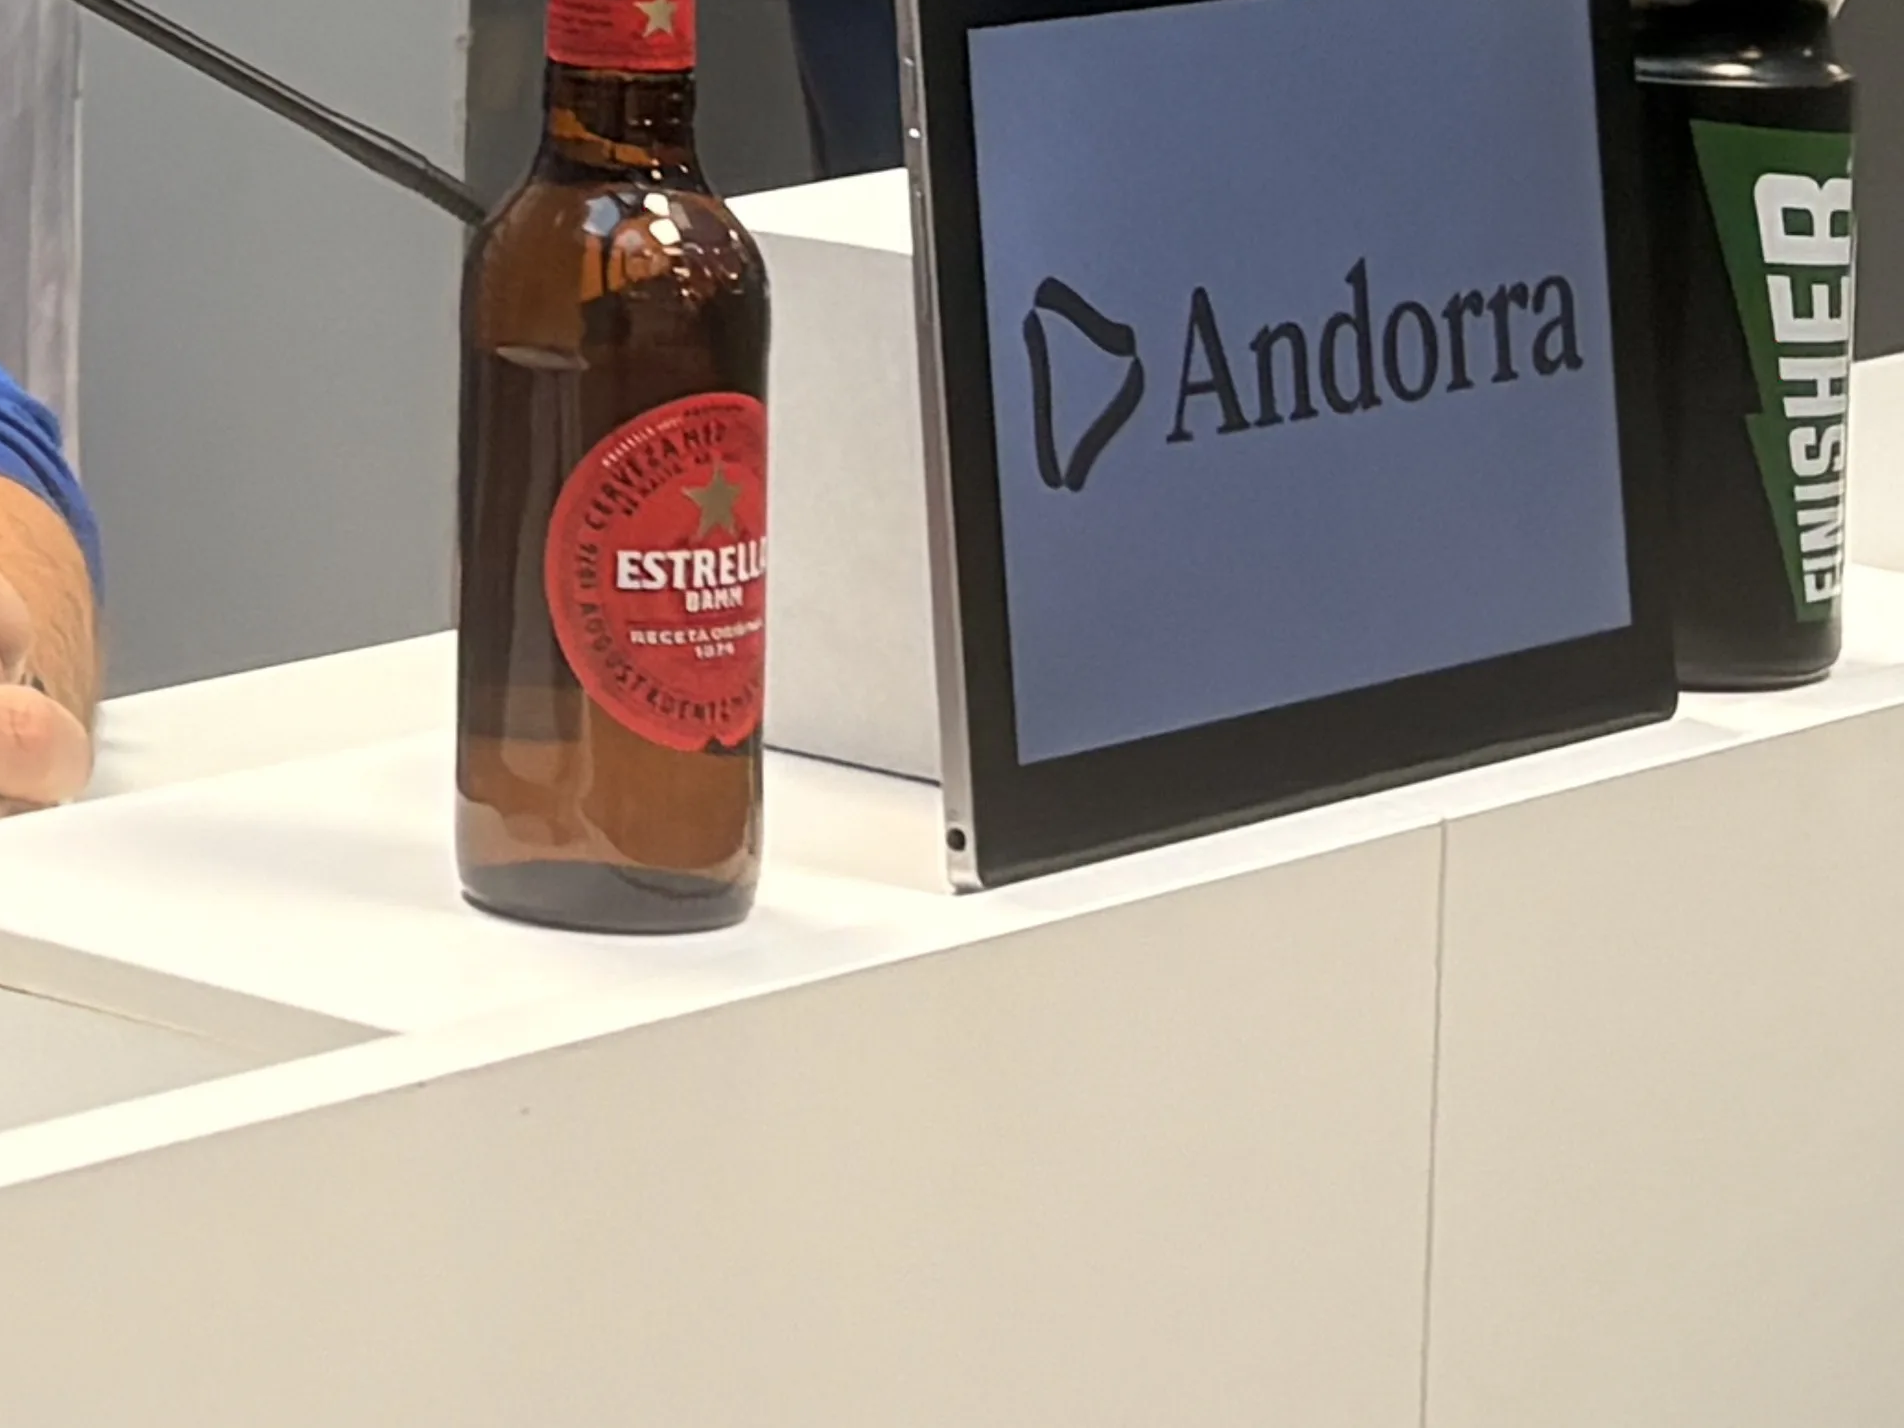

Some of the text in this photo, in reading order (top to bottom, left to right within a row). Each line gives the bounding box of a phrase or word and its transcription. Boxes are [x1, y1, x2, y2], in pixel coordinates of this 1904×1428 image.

[1166, 258, 1583, 443] Andorra
[617, 535, 767, 591] ESTRELL
[685, 585, 744, 612] DAMM
